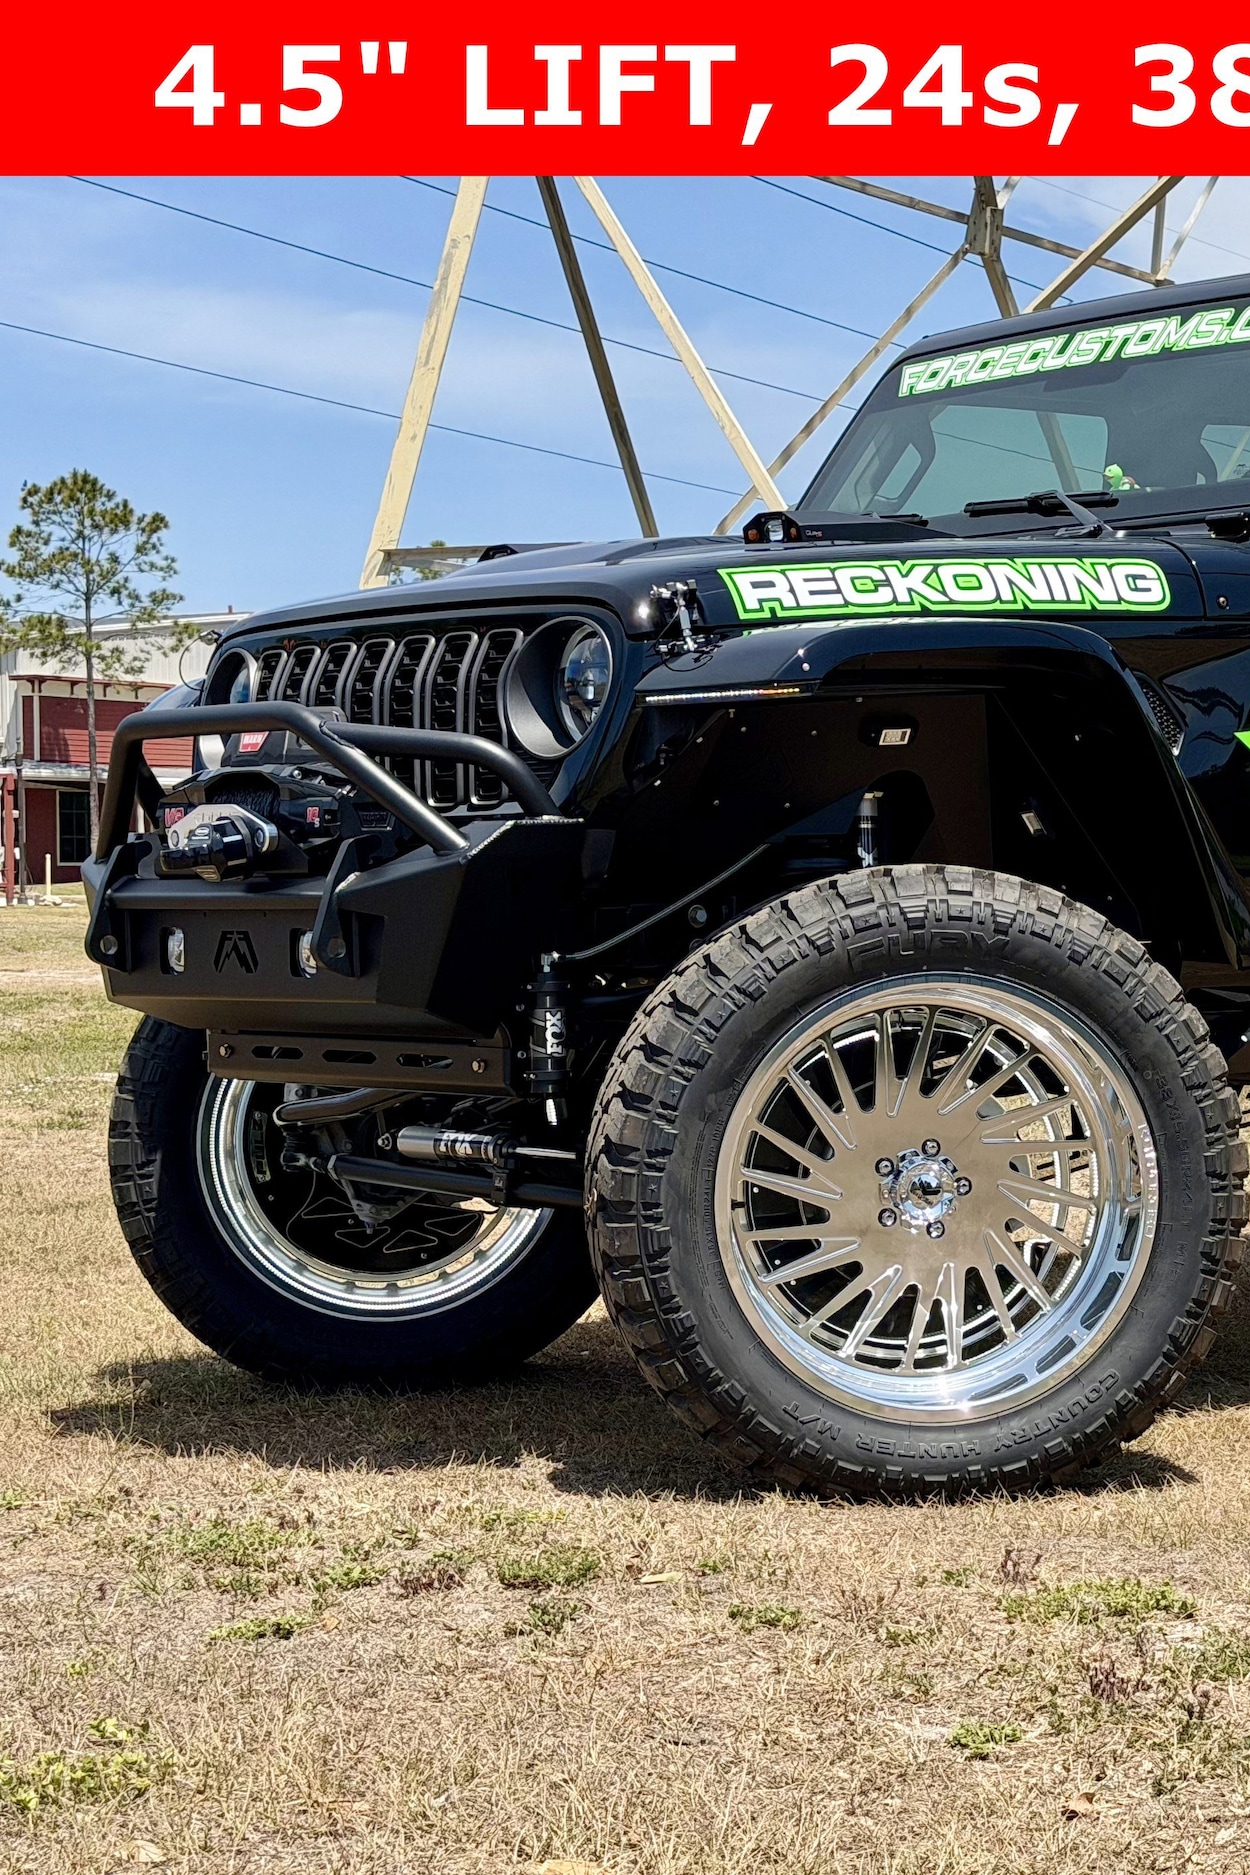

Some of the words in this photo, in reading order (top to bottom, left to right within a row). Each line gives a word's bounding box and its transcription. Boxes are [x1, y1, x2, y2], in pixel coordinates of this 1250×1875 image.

[724, 560, 1168, 616] RECKONING
[545, 1010, 563, 1057] FOX
[781, 1400, 842, 1441] M/T
[993, 1367, 1121, 1447] COUNTRY
[854, 1431, 983, 1459] HUNTER
